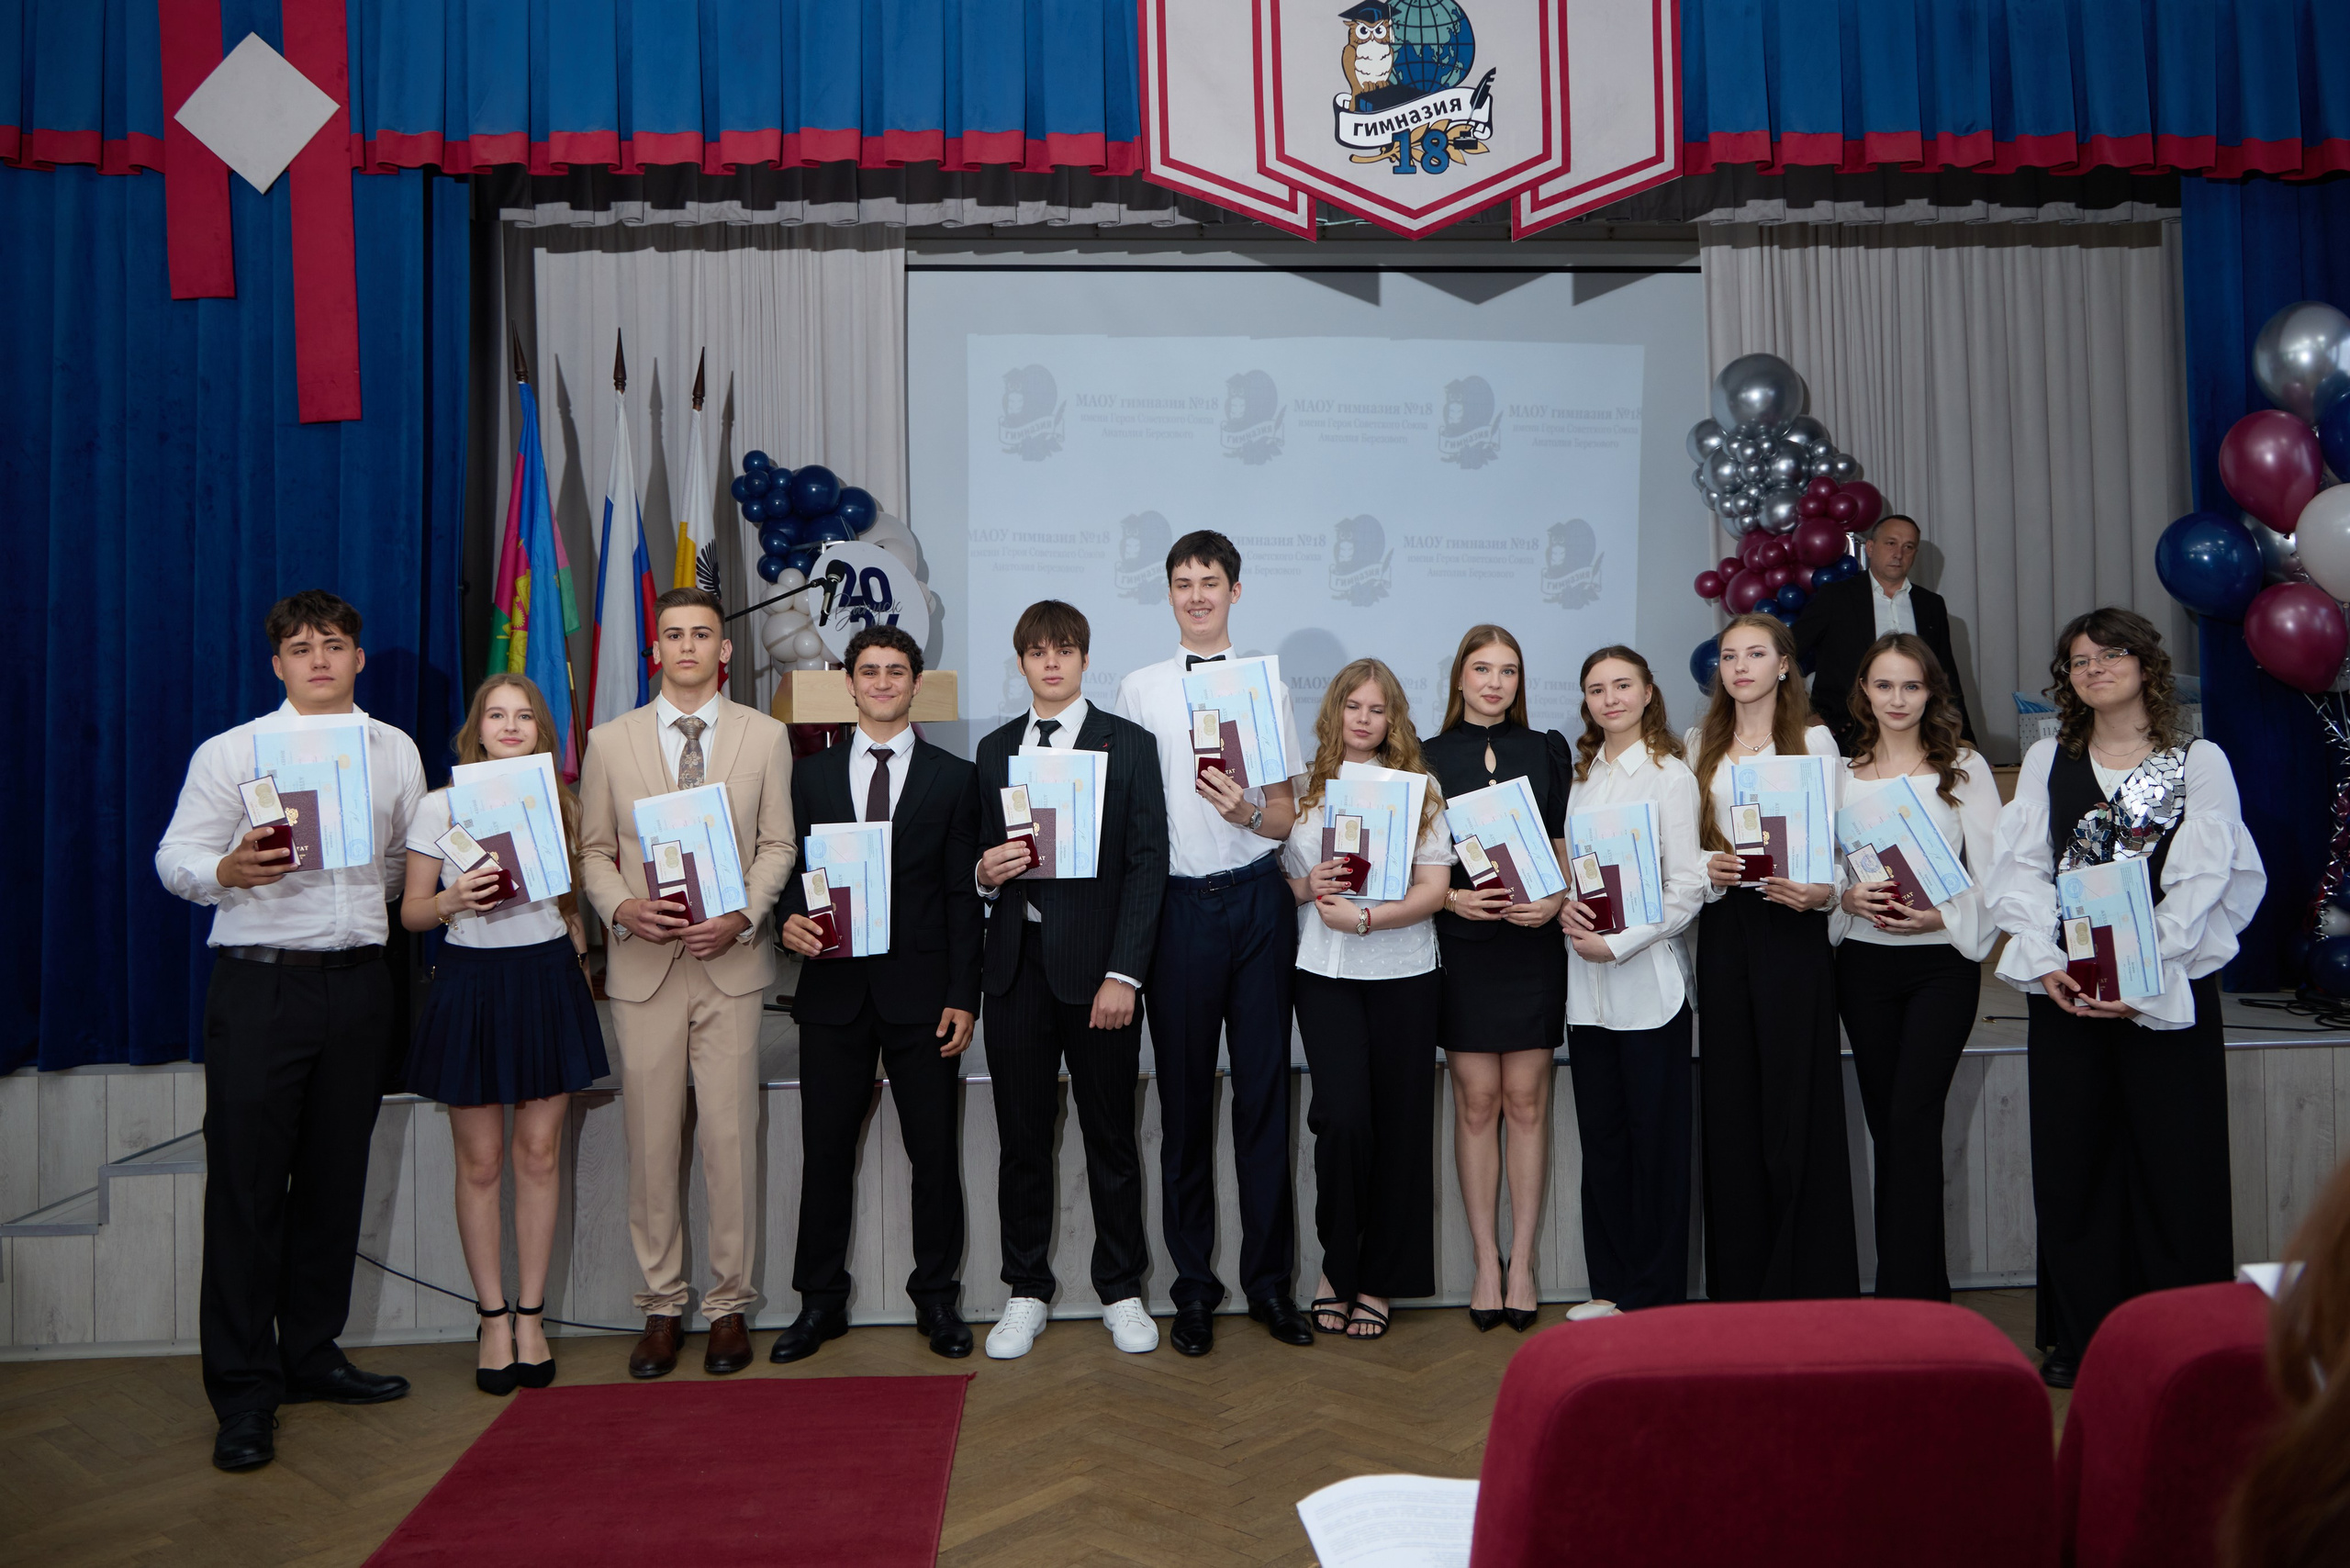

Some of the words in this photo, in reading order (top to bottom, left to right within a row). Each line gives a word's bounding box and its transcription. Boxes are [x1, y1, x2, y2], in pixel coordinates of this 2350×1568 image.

[1353, 98, 1462, 137] гимназия
[1392, 129, 1449, 174] 18
[1075, 394, 1118, 408] МАОУ
[1121, 398, 1185, 409] гимназия
[1293, 399, 1335, 412] МАОУ
[1337, 403, 1400, 415] гимназия
[1508, 405, 1548, 418] МАОУ
[1551, 409, 1612, 420] гимназия
[1012, 532, 1076, 543] гимназия
[1404, 536, 1443, 548] МАОУ
[1446, 539, 1506, 550] гимназия
